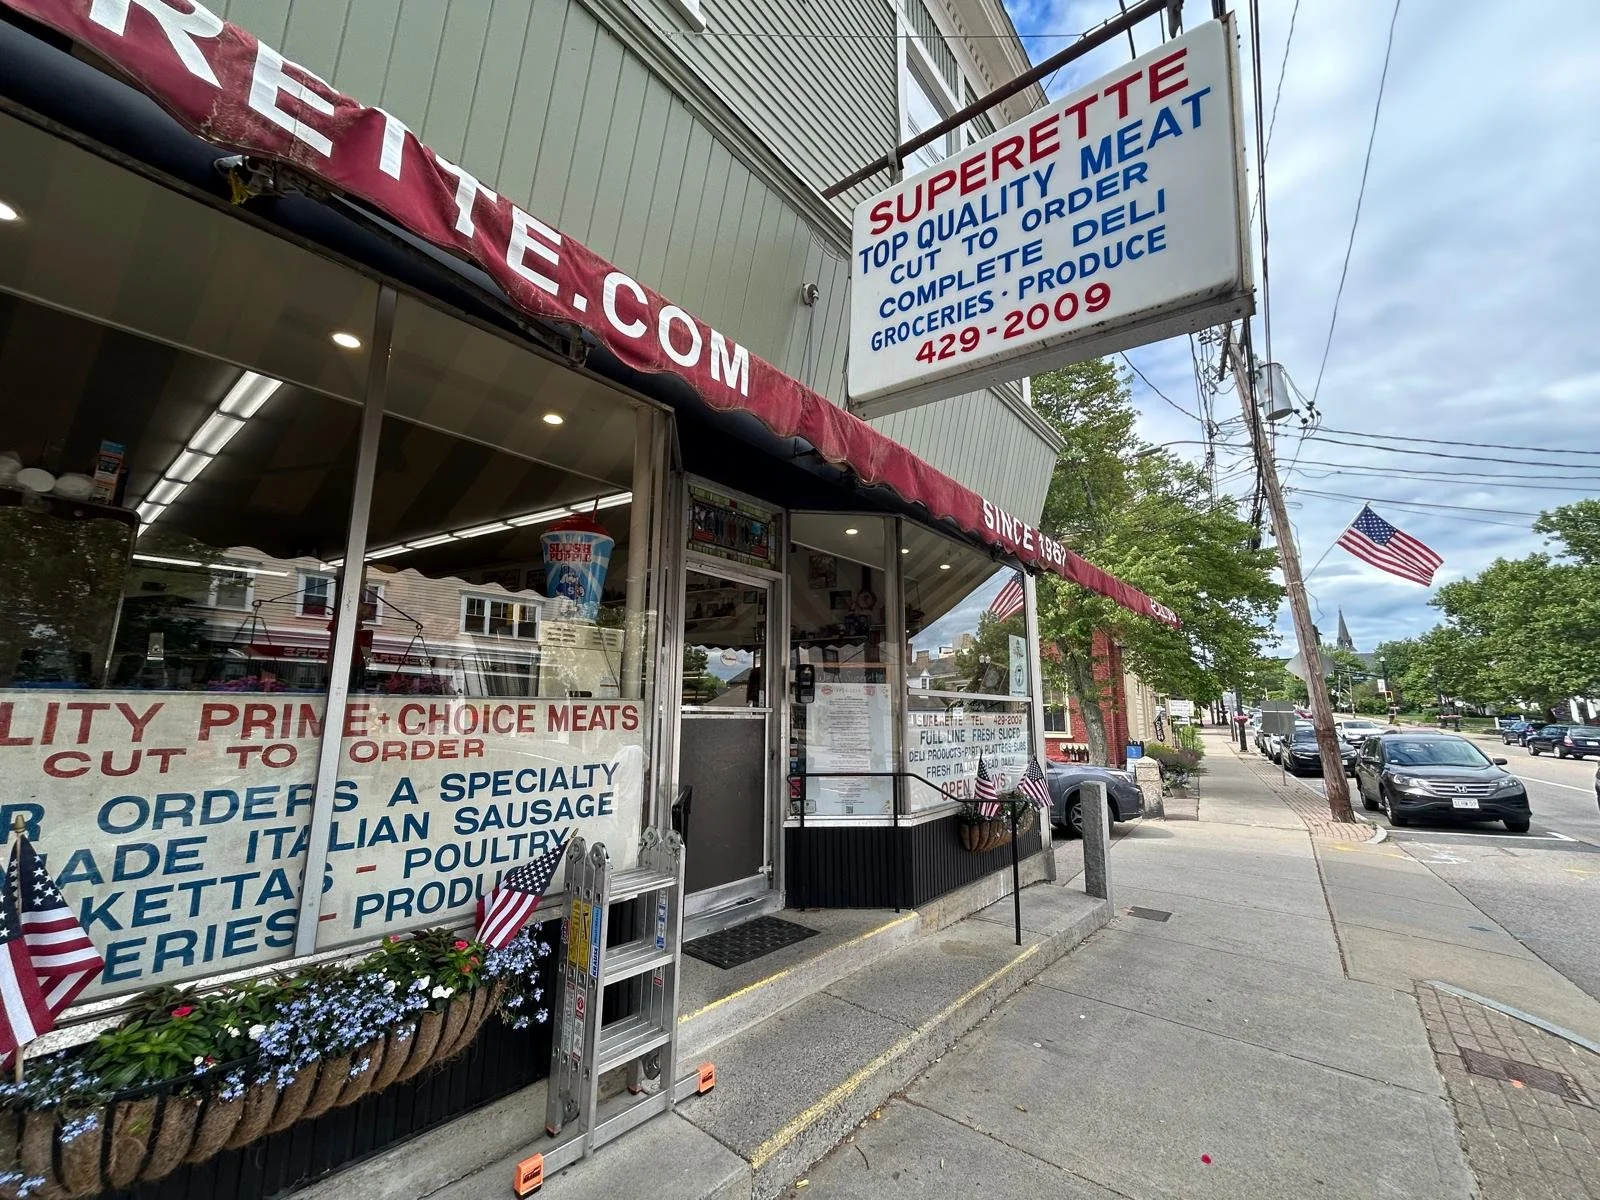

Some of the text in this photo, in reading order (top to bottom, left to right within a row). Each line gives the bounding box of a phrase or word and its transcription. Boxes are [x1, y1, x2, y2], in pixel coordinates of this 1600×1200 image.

[869, 47, 1189, 236] SUPERETTE
[858, 86, 1211, 275] TOP QUALITY MEAT
[878, 187, 1166, 319] COMPLETE DELI
[889, 161, 1148, 285] CUT TO ORDER
[870, 288, 995, 352] GROCERIES
[1018, 224, 1168, 301] PRODUCE
[915, 281, 1112, 365] 429-2009
[549, 543, 592, 554] SLUSH
[982, 499, 1067, 568] SINCE 1967
[0, 702, 164, 746] LITY
[198, 703, 370, 741] PRIME
[399, 703, 535, 736] CHOICE
[547, 703, 640, 732] MEATS
[908, 750, 926, 762] DELI
[920, 727, 1021, 745] FULL LINE FRESH SLICED
[43, 739, 485, 779] CUT TO ORDER
[926, 765, 951, 778] FRESH
[941, 778, 970, 801] OPEN
[97, 780, 359, 835] ORDERS
[388, 776, 419, 806] A
[440, 762, 620, 801] SPECIALTY
[38, 836, 208, 892] ADE
[454, 791, 615, 835] SAUSAGE
[403, 826, 570, 879] POULTRY
[353, 865, 525, 930] PRODU
